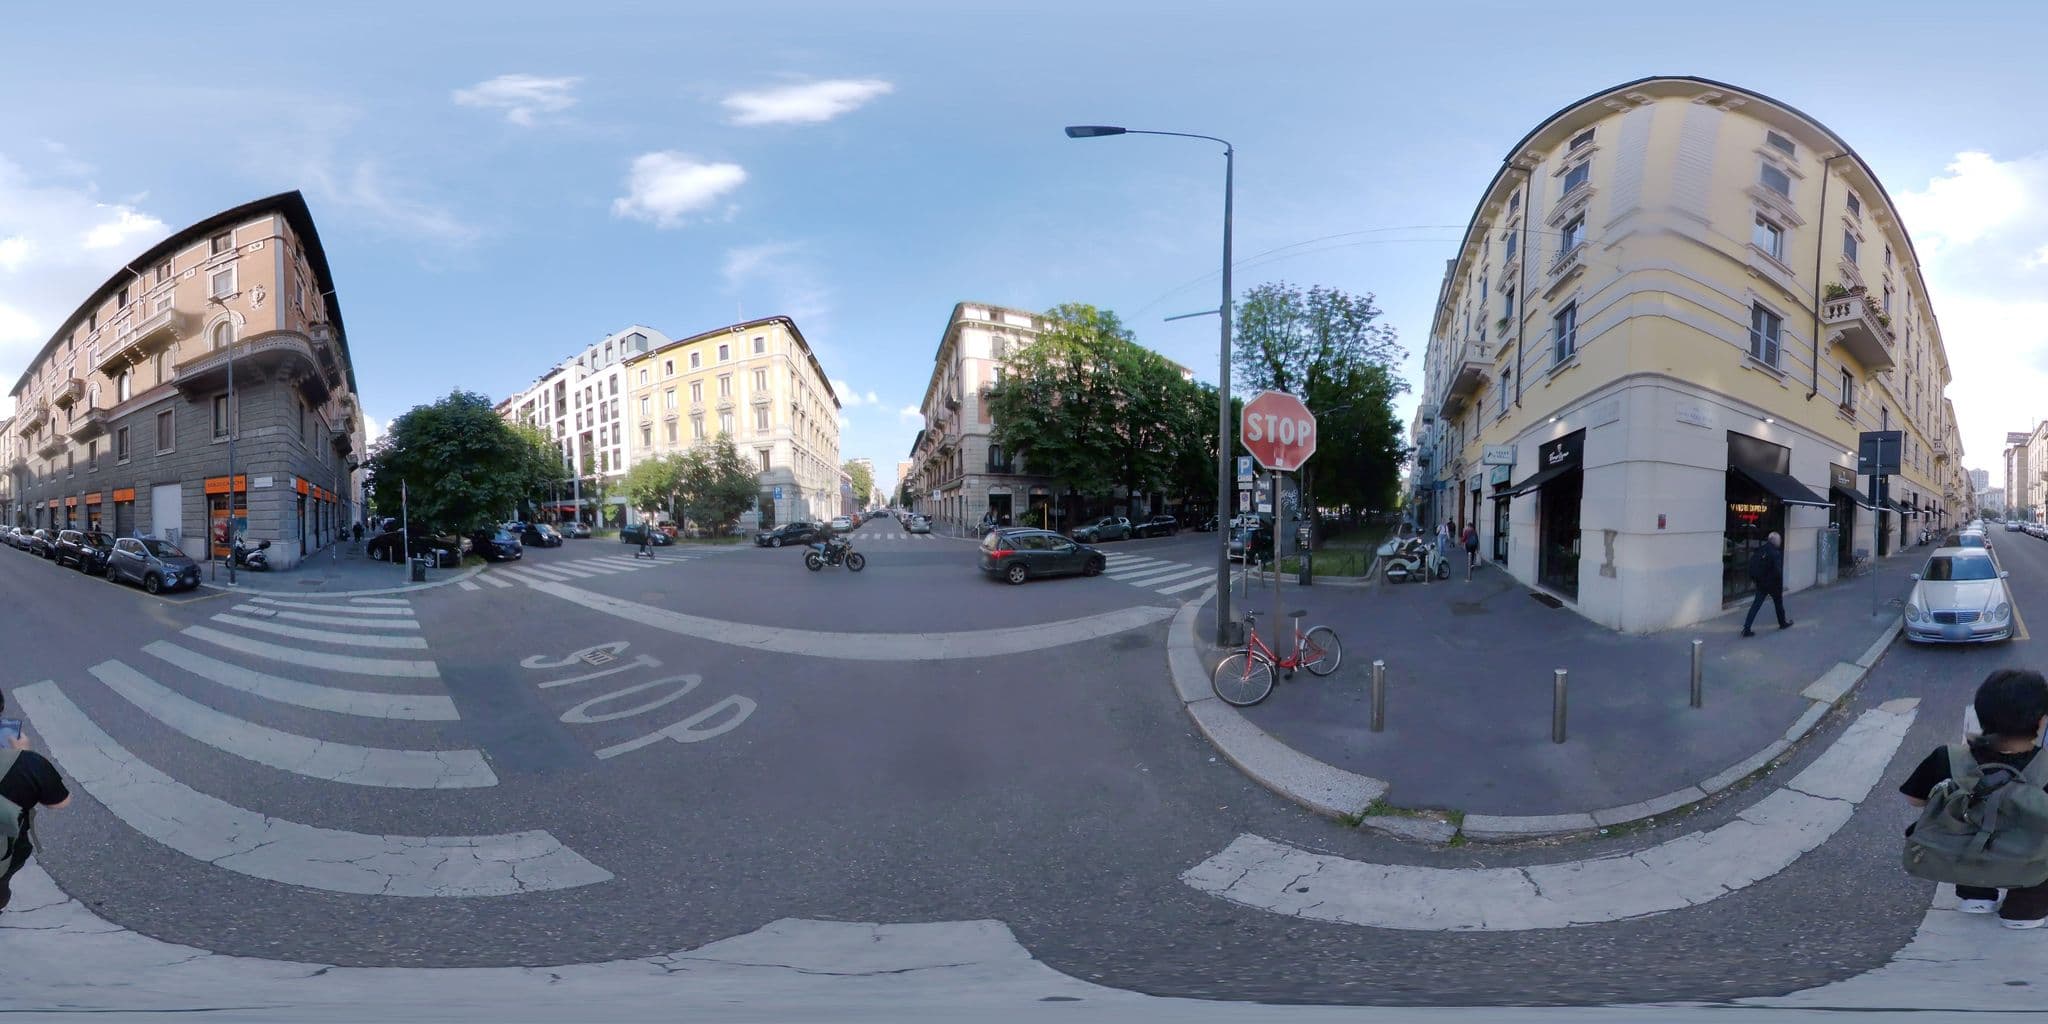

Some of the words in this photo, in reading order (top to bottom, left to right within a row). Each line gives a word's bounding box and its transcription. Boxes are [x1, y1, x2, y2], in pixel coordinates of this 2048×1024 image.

[1247, 412, 1312, 447] STOP
[1240, 459, 1250, 474] P
[520, 641, 757, 760] STOP
